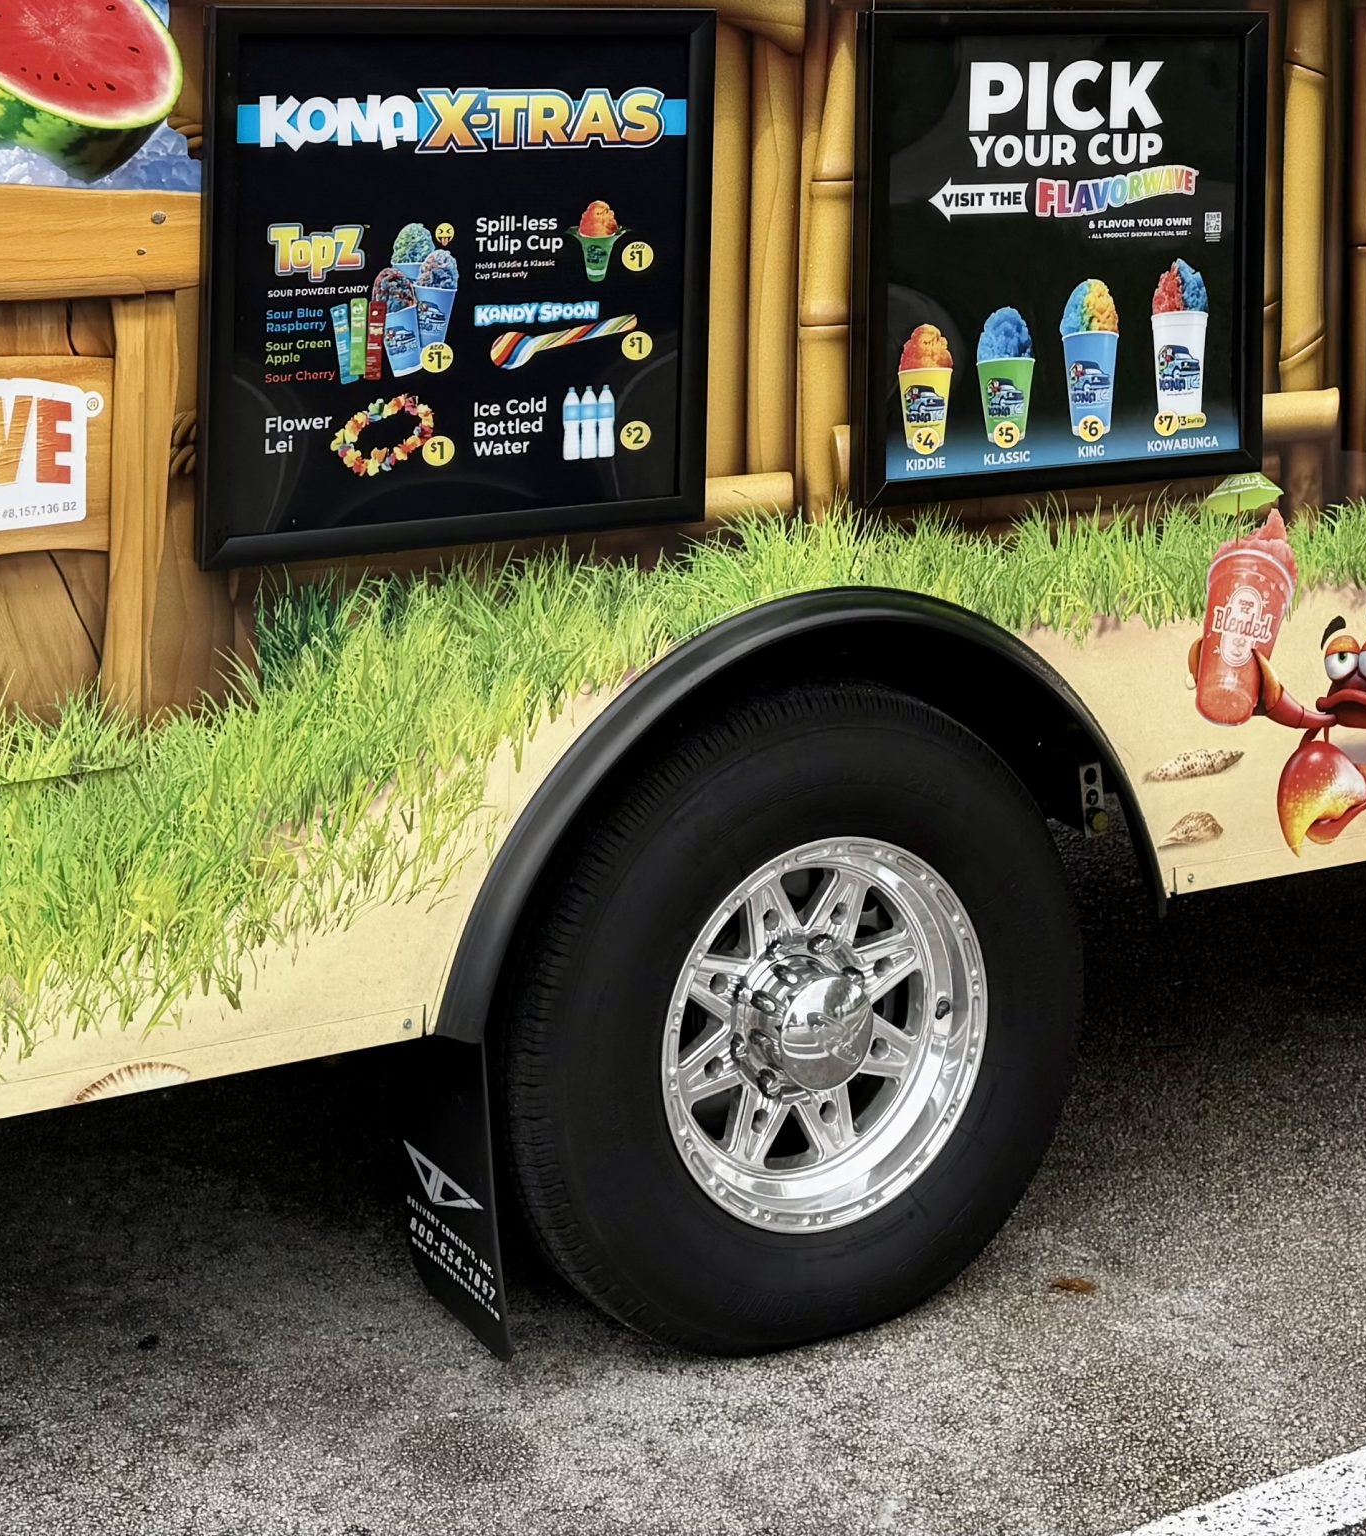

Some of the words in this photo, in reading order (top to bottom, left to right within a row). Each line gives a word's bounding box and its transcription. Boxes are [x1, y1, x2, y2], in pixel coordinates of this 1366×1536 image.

[968, 59, 1165, 133] PICK
[259, 93, 419, 152] KONA
[418, 87, 665, 153] X-TRAS
[968, 134, 1077, 168] YOUR
[1087, 133, 1163, 165] CUP
[1037, 166, 1195, 215] FLAVORWAVE
[941, 191, 986, 209] VISIT
[989, 190, 1023, 207] THE
[476, 216, 558, 236] Spill-less
[1089, 220, 1095, 229] &
[1098, 219, 1134, 229] FLAVOR
[1137, 218, 1163, 227] YOUR
[1165, 217, 1192, 227] OWN!
[475, 236, 522, 255] Tulip
[526, 236, 563, 253] Cup
[498, 260, 522, 268] Kiddie
[530, 259, 555, 267] Klassic
[630, 250, 643, 268] $1
[475, 272, 490, 280] Cup
[491, 271, 511, 279] Sizes
[512, 271, 528, 279] only
[267, 290, 293, 298] SOUR
[295, 287, 336, 297] POWDER
[337, 285, 369, 294] CANDY
[266, 309, 295, 320] Sour
[298, 308, 324, 318] Blue
[475, 304, 537, 325] KANDY
[539, 302, 599, 322] SPOON
[266, 319, 327, 334] Raspberry
[265, 341, 294, 352] Sour
[296, 339, 332, 350] Green
[629, 337, 642, 354] $1
[265, 352, 301, 366] Apple
[427, 351, 442, 369] $1
[265, 373, 293, 384] Sour
[295, 370, 336, 382] Cherry
[1159, 378, 1185, 392] KONA
[474, 402, 501, 418] Ice
[506, 396, 547, 414] Cold
[265, 415, 333, 434] Flower
[474, 417, 543, 437] Bottled
[1083, 421, 1099, 436] $6
[1159, 416, 1173, 431] $7
[626, 426, 644, 444] $2
[917, 433, 934, 449] $4
[999, 428, 1014, 443] $5
[1147, 435, 1219, 452] KOWABUNGA
[264, 435, 293, 455] Lei
[430, 441, 444, 460] $1
[474, 440, 530, 457] Water
[1078, 445, 1105, 458] KING
[906, 457, 946, 471] KIDDIE
[984, 451, 1030, 465] KLASSIC
[2, 504, 59, 519] #8,157,136
[63, 502, 77, 512] B2
[1214, 608, 1271, 640] Blended
[406, 1195, 440, 1228] DELIVERY
[441, 1223, 478, 1264] CONCEPTS,
[479, 1258, 495, 1279] INC.
[409, 1217, 497, 1301] 800-654-1857
